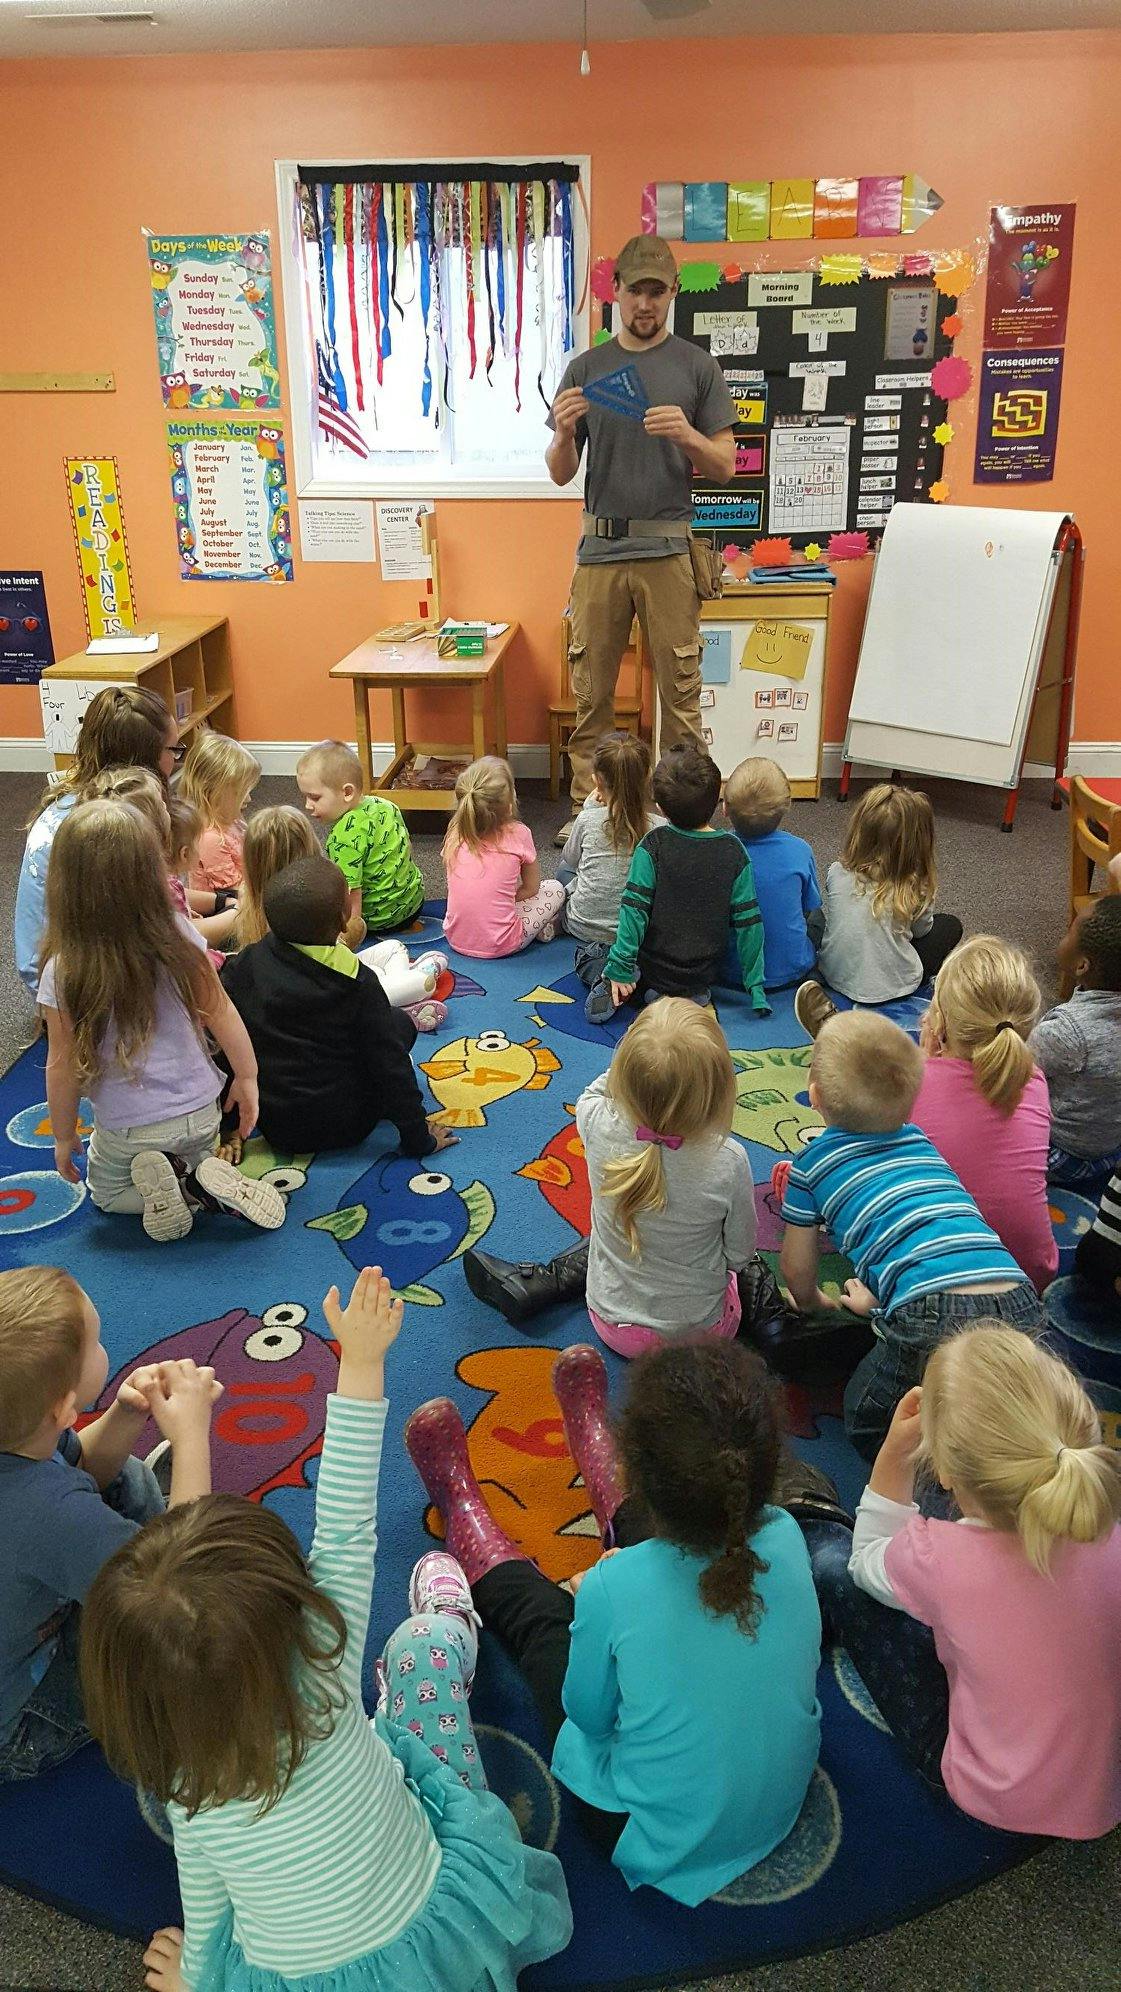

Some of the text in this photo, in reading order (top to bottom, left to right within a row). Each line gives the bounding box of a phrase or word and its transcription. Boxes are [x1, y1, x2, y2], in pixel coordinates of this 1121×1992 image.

[1004, 212, 1062, 227] Empathy
[151, 240, 187, 256] Days
[196, 242, 207, 250] the
[206, 238, 243, 253] Week
[184, 273, 218, 285] Sunday
[762, 284, 799, 293] Morning
[179, 290, 215, 301] Monday
[766, 295, 794, 303] Board
[187, 306, 225, 317] Tuesday
[182, 322, 234, 333] Wednesday
[190, 337, 234, 349] Thursday
[718, 340, 726, 349] D
[185, 354, 215, 364] Friday
[987, 357, 1059, 368] Consequences
[193, 368, 236, 380] Saturday
[168, 424, 218, 437] Months
[226, 423, 258, 437] Year
[794, 434, 831, 442] February
[194, 444, 225, 453] January
[194, 454, 230, 464] February
[196, 465, 219, 473] March
[197, 476, 215, 485] April
[198, 487, 213, 495] May
[691, 494, 742, 504] Tomorrow
[200, 508, 215, 517] July
[381, 507, 414, 515] DISCOVERY
[201, 519, 227, 528] August
[202, 530, 243, 539] September
[203, 540, 234, 548] October
[204, 551, 242, 559] November
[13, 577, 40, 585] Intent
[756, 620, 810, 644] Good Friend
[462, 1067, 522, 1087] 4
[376, 1219, 452, 1246] 8
[216, 1373, 317, 1446] 10
